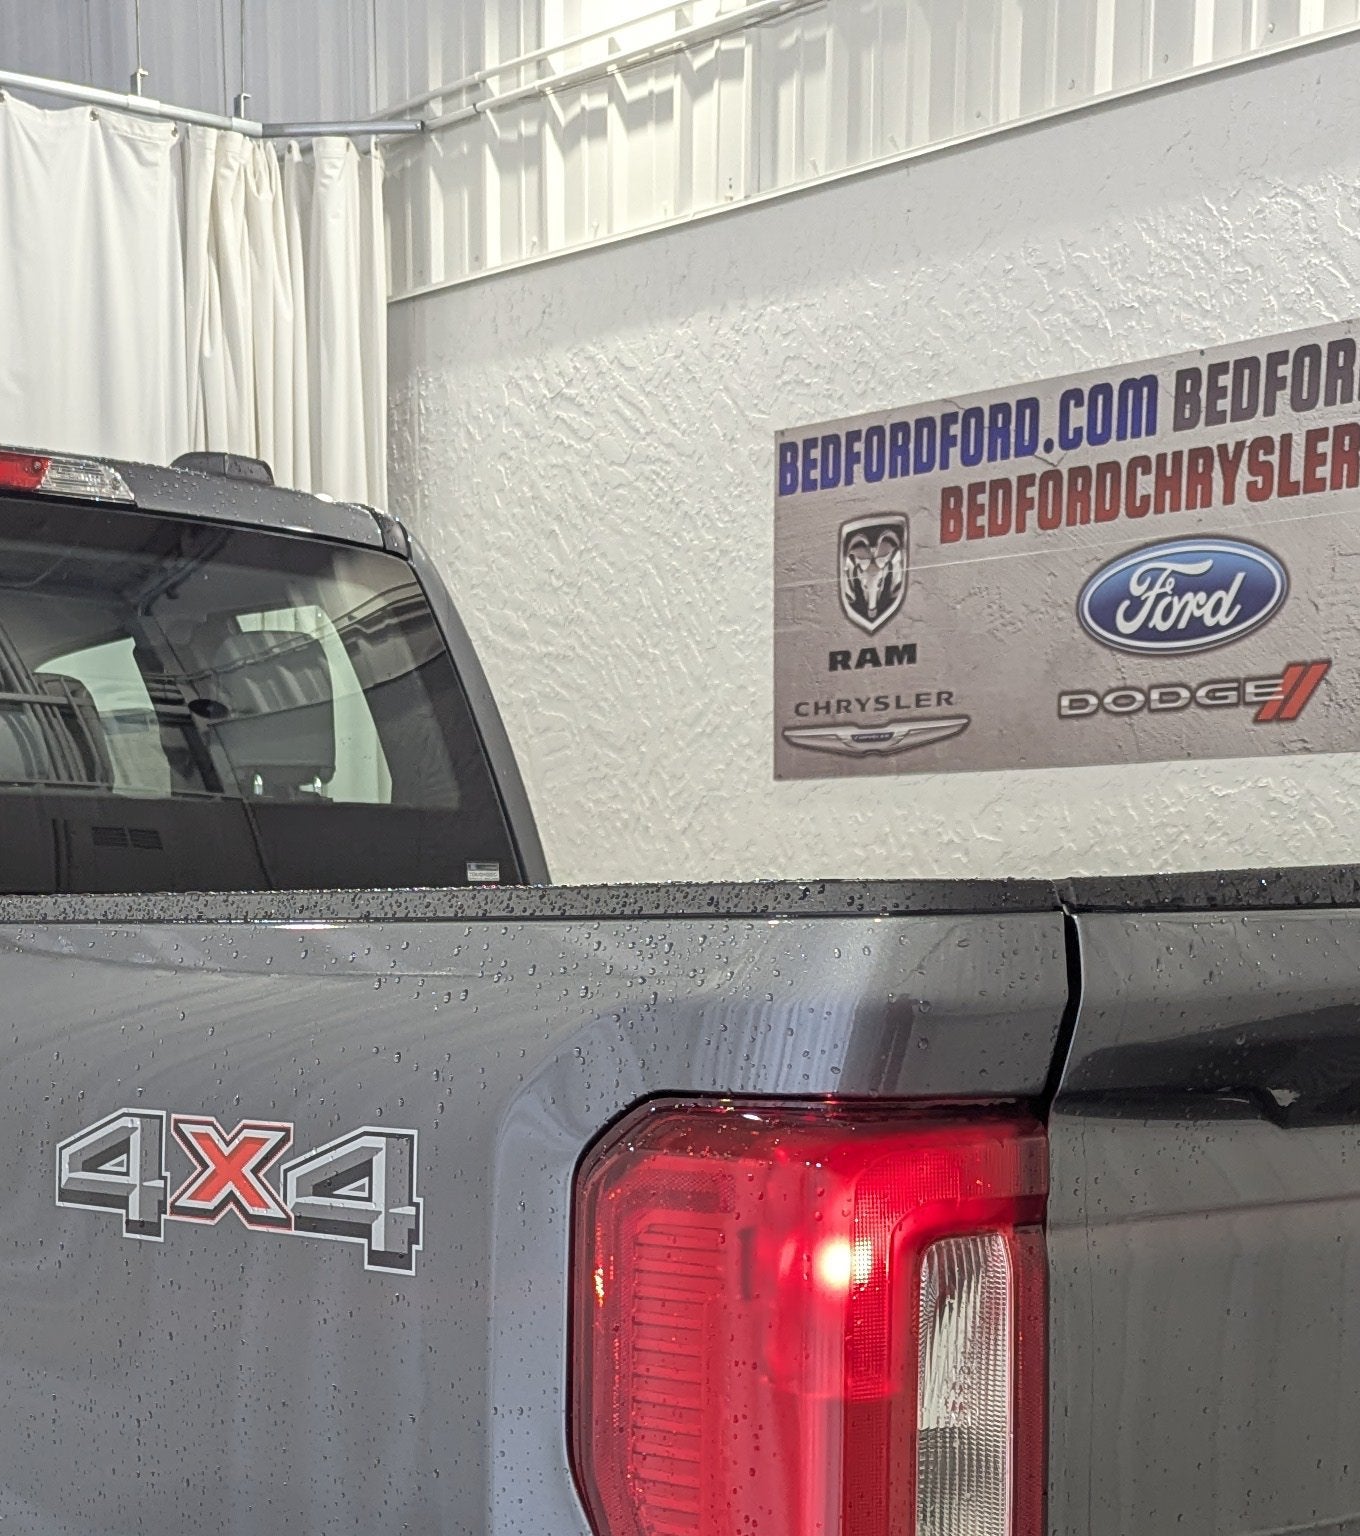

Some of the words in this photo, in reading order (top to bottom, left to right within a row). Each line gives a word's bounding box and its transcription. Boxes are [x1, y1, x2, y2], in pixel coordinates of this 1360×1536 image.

[778, 374, 1159, 496] BEDFORDFORD.COM
[1115, 559, 1246, 635] Ford
[828, 643, 917, 672] RAM
[794, 690, 955, 718] CHRYSLER
[1059, 676, 1285, 718] DODGE
